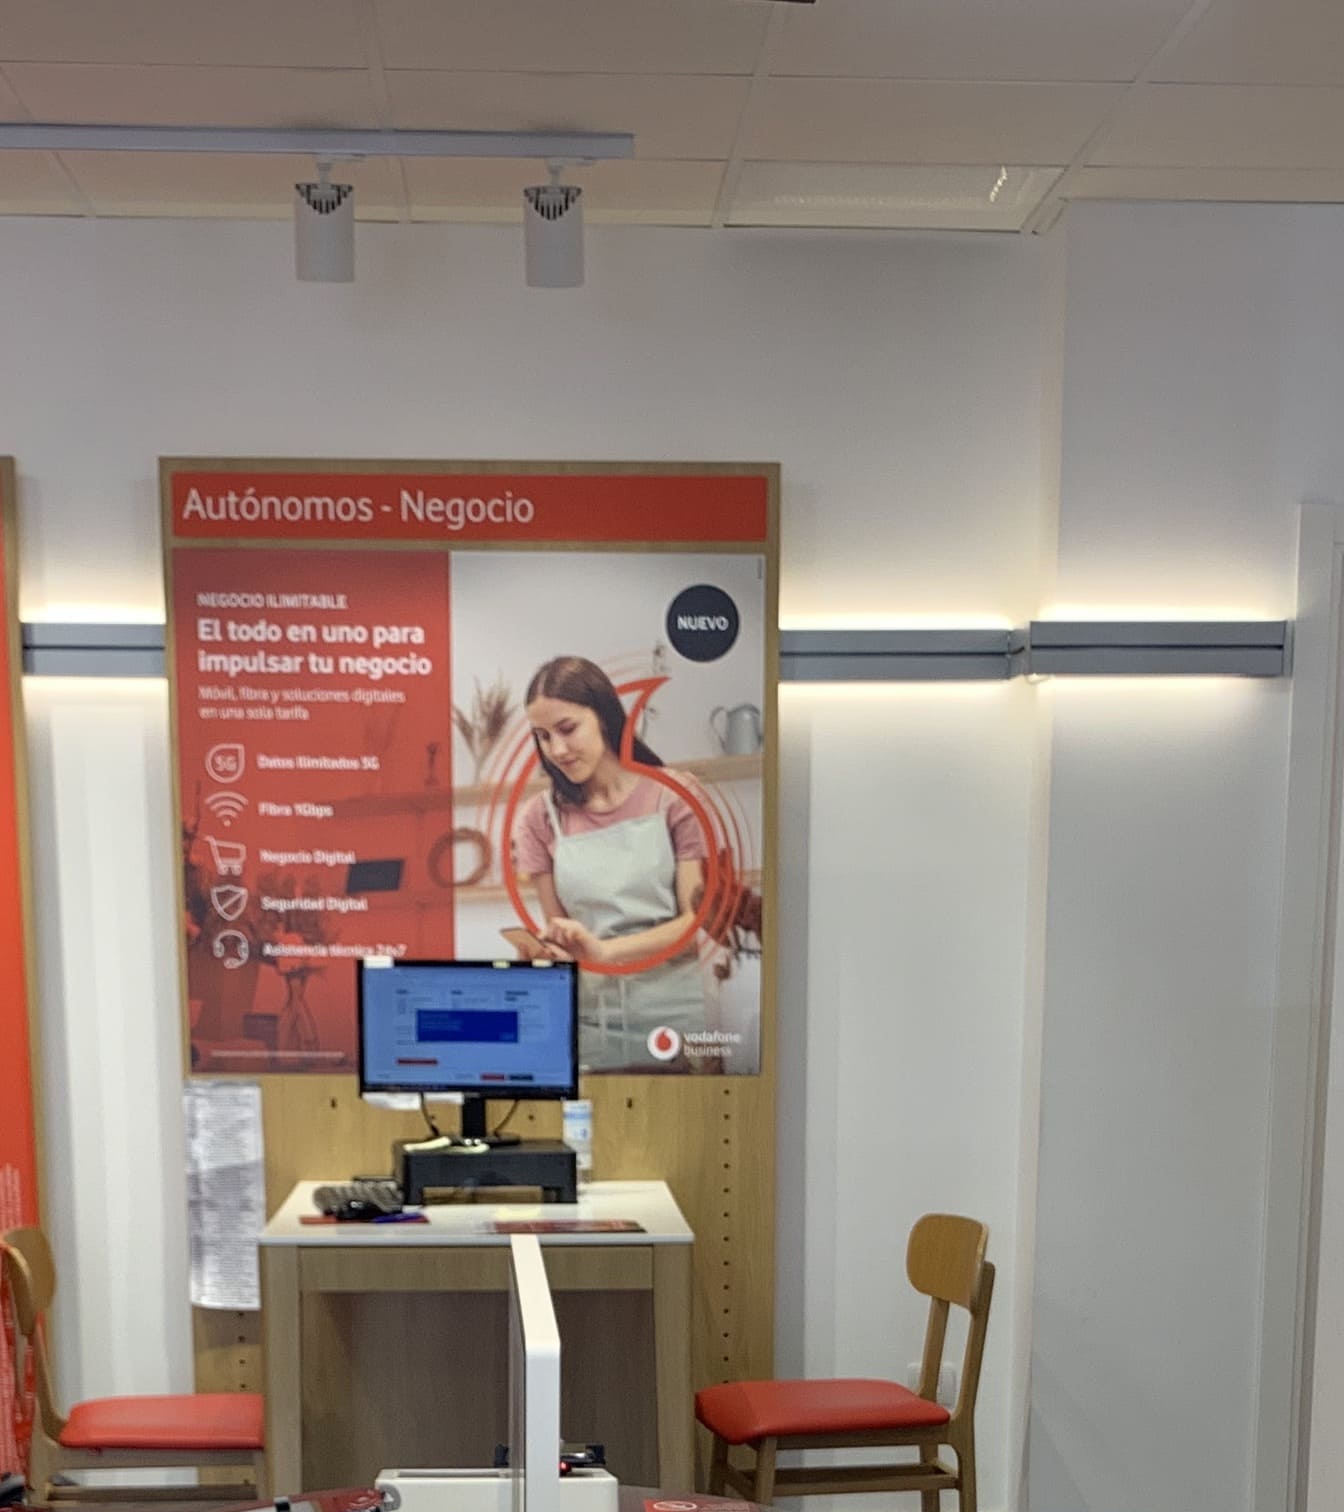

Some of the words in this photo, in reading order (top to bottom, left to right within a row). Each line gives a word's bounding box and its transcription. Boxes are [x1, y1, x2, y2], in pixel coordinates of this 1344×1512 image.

[182, 488, 374, 522] Autónomos
[400, 490, 534, 529] Negocio
[197, 593, 264, 608] NEGOCIO
[267, 594, 348, 609] ILIMITABLE
[677, 615, 729, 631] NUEVO
[198, 618, 221, 641] El
[227, 619, 282, 642] todo
[286, 625, 317, 642] en
[322, 626, 368, 643] uno
[373, 626, 424, 649] para
[198, 650, 304, 677] impulsar
[309, 653, 333, 673] tu
[340, 652, 432, 680] negocio
[270, 690, 279, 704] y
[281, 688, 349, 702] soluciones
[352, 688, 406, 706] digitales
[214, 755, 238, 772] 5G
[313, 850, 356, 867] Digital
[327, 897, 368, 914] Digital
[683, 1030, 741, 1043] vodafone
[684, 1044, 733, 1057] business
